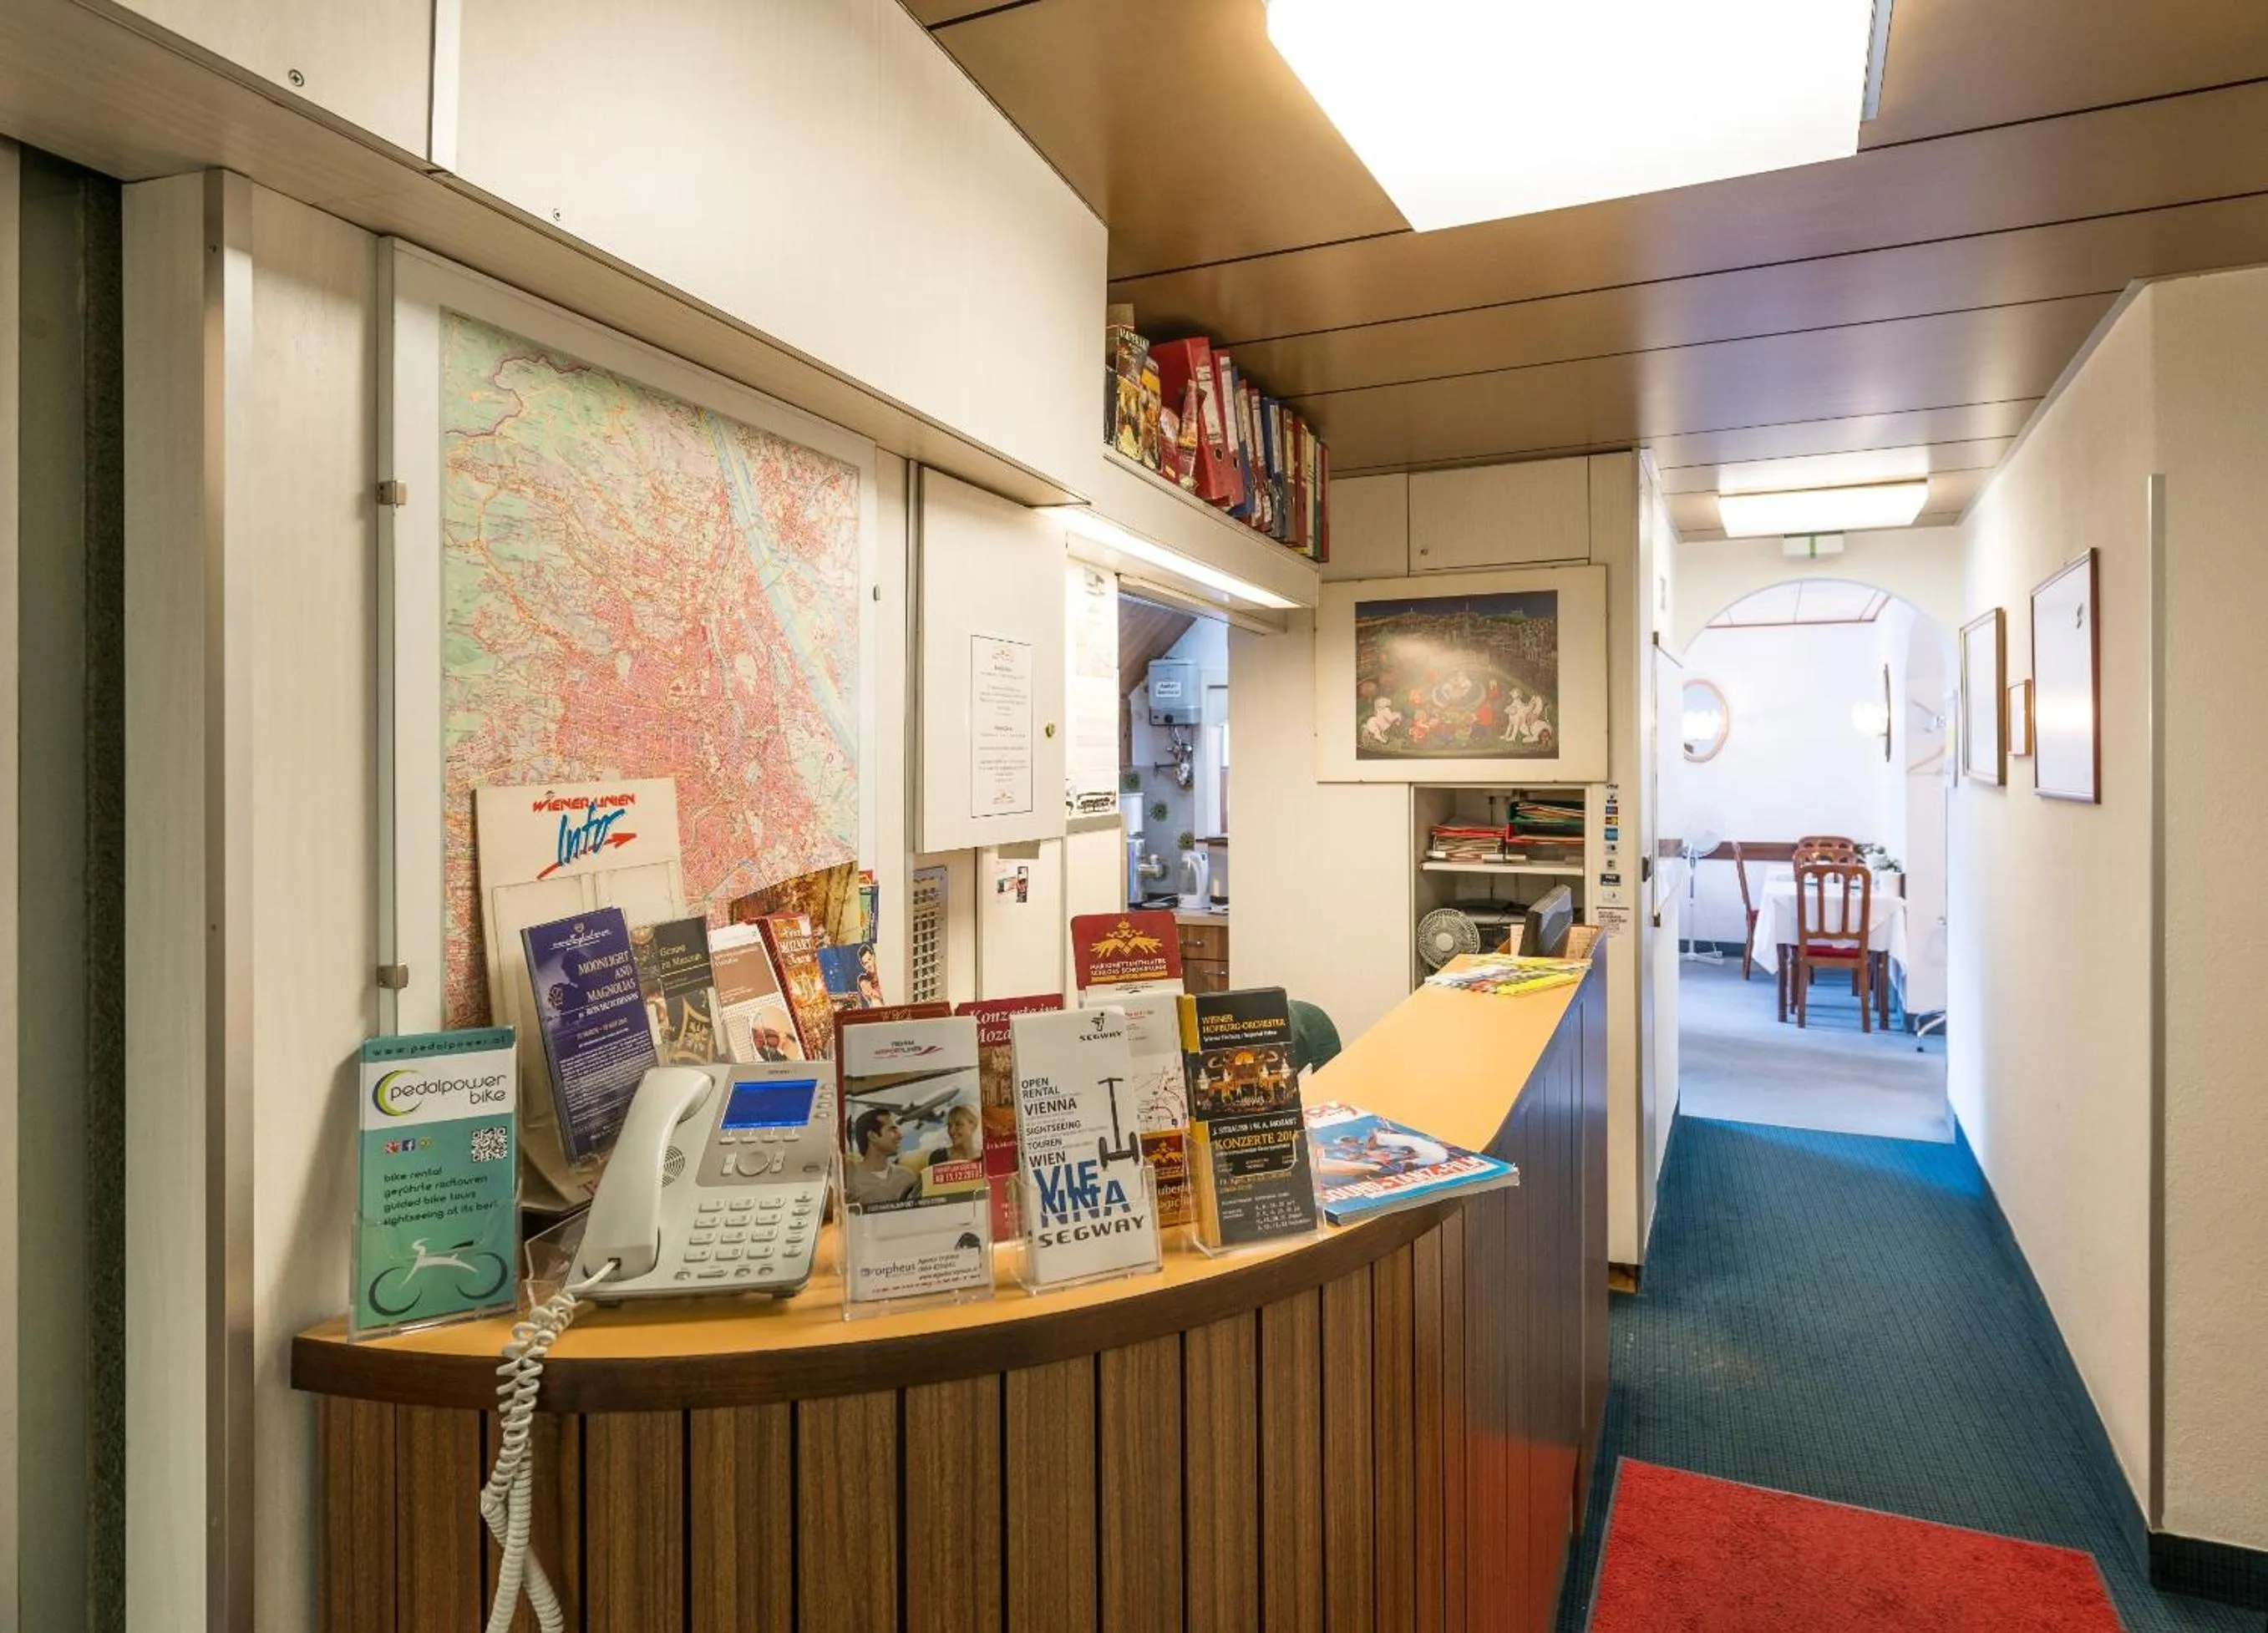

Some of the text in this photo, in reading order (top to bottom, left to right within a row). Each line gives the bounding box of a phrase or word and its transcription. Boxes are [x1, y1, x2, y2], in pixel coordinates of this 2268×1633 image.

[533, 797, 590, 813] WIENER
[557, 802, 626, 866] Info
[578, 951, 629, 976] MOONLIGHT
[615, 964, 633, 979] AND
[1079, 1031, 1123, 1042] SEGWAY
[390, 1074, 507, 1101] pedalpower
[1022, 1078, 1049, 1089] OPEN
[469, 1089, 506, 1104] bike
[1022, 1086, 1060, 1098] RENTAL
[1024, 1098, 1078, 1116] VIENNA
[1026, 1120, 1082, 1136] SIGHTSEEING
[1027, 1138, 1063, 1150] TOUREN
[1214, 1133, 1276, 1150] KONZERTE
[1028, 1150, 1066, 1168] WIEN
[383, 1168, 443, 1182] bike rental
[434, 1174, 488, 1189] radtouren
[383, 1199, 421, 1213] guided
[424, 1195, 446, 1204] bike
[383, 1210, 444, 1227] sightseeing
[1038, 1215, 1145, 1249] SEGWAY
